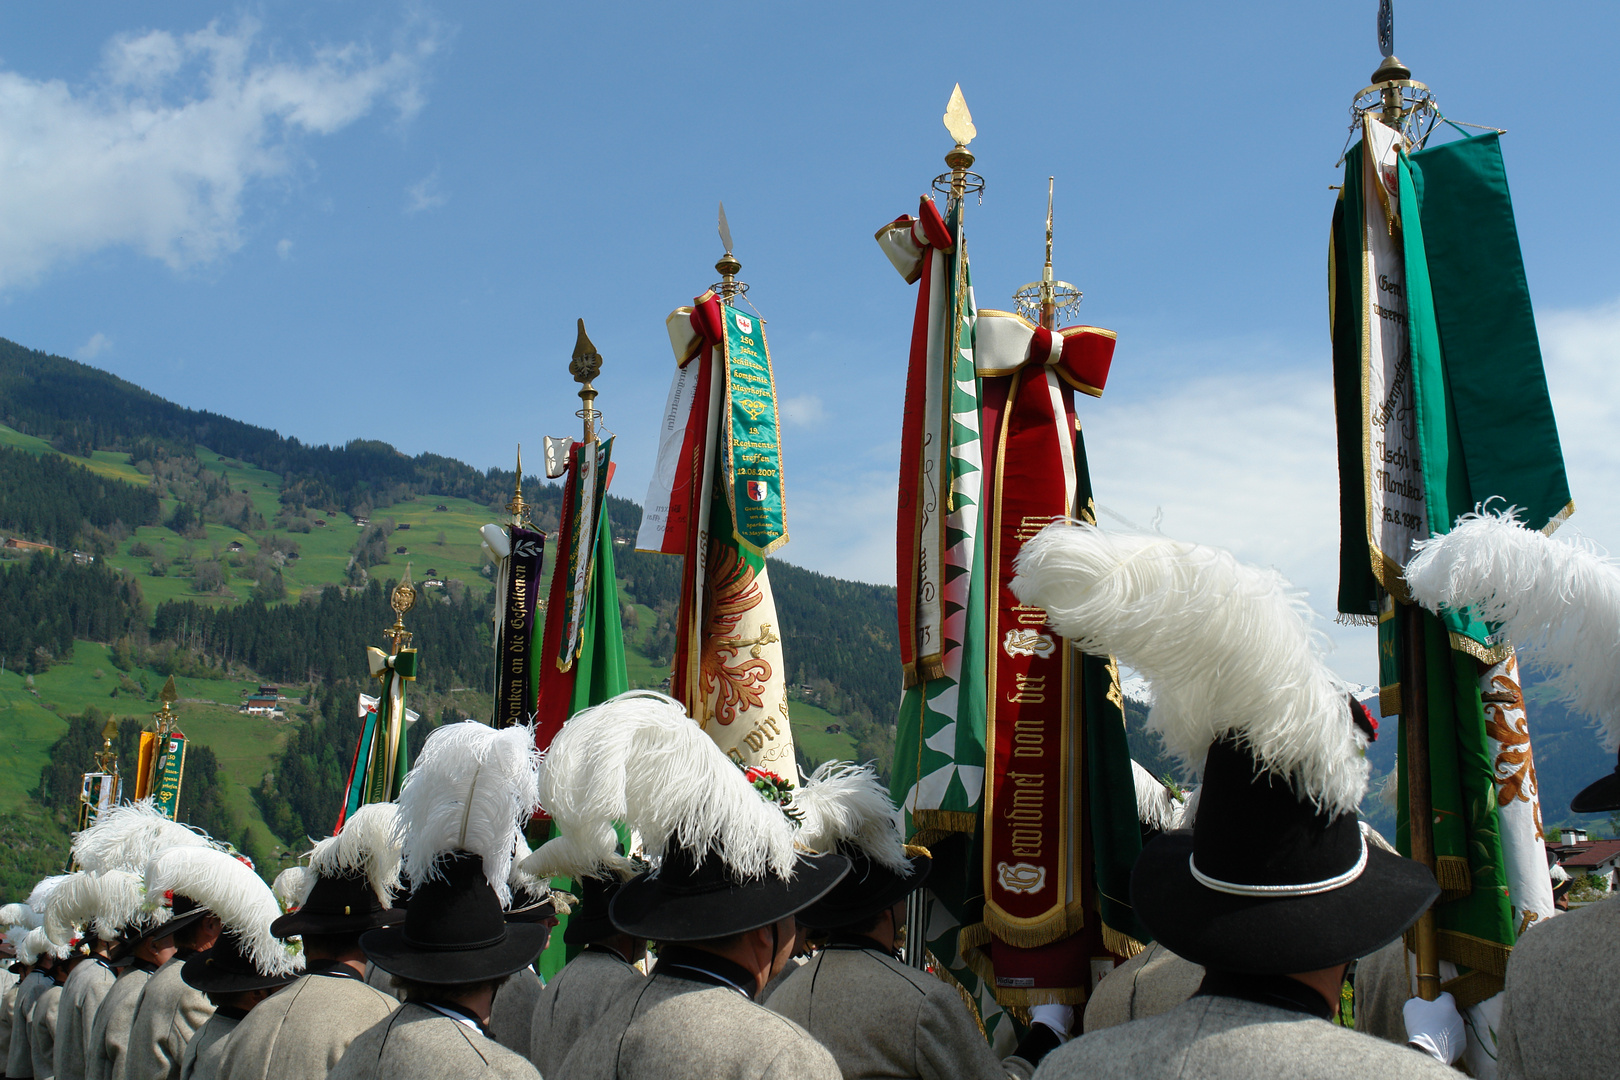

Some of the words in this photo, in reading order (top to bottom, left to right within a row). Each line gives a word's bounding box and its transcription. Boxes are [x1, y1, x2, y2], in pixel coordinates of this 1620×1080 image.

[740, 335, 755, 347] 150
[740, 345, 758, 358] Jahre
[733, 369, 768, 385] kompanie
[732, 382, 772, 398] Mayrhofen
[741, 453, 770, 464] treffen
[1375, 440, 1410, 472] Uschi
[1375, 468, 1424, 502] Monika
[1381, 505, 1423, 532] 16.8.1987
[510, 564, 529, 630] Gefallenen
[509, 634, 525, 653] die
[511, 657, 524, 674] an
[1006, 672, 1046, 704] der
[1013, 719, 1045, 758] von
[998, 770, 1045, 892] Gewidmet
